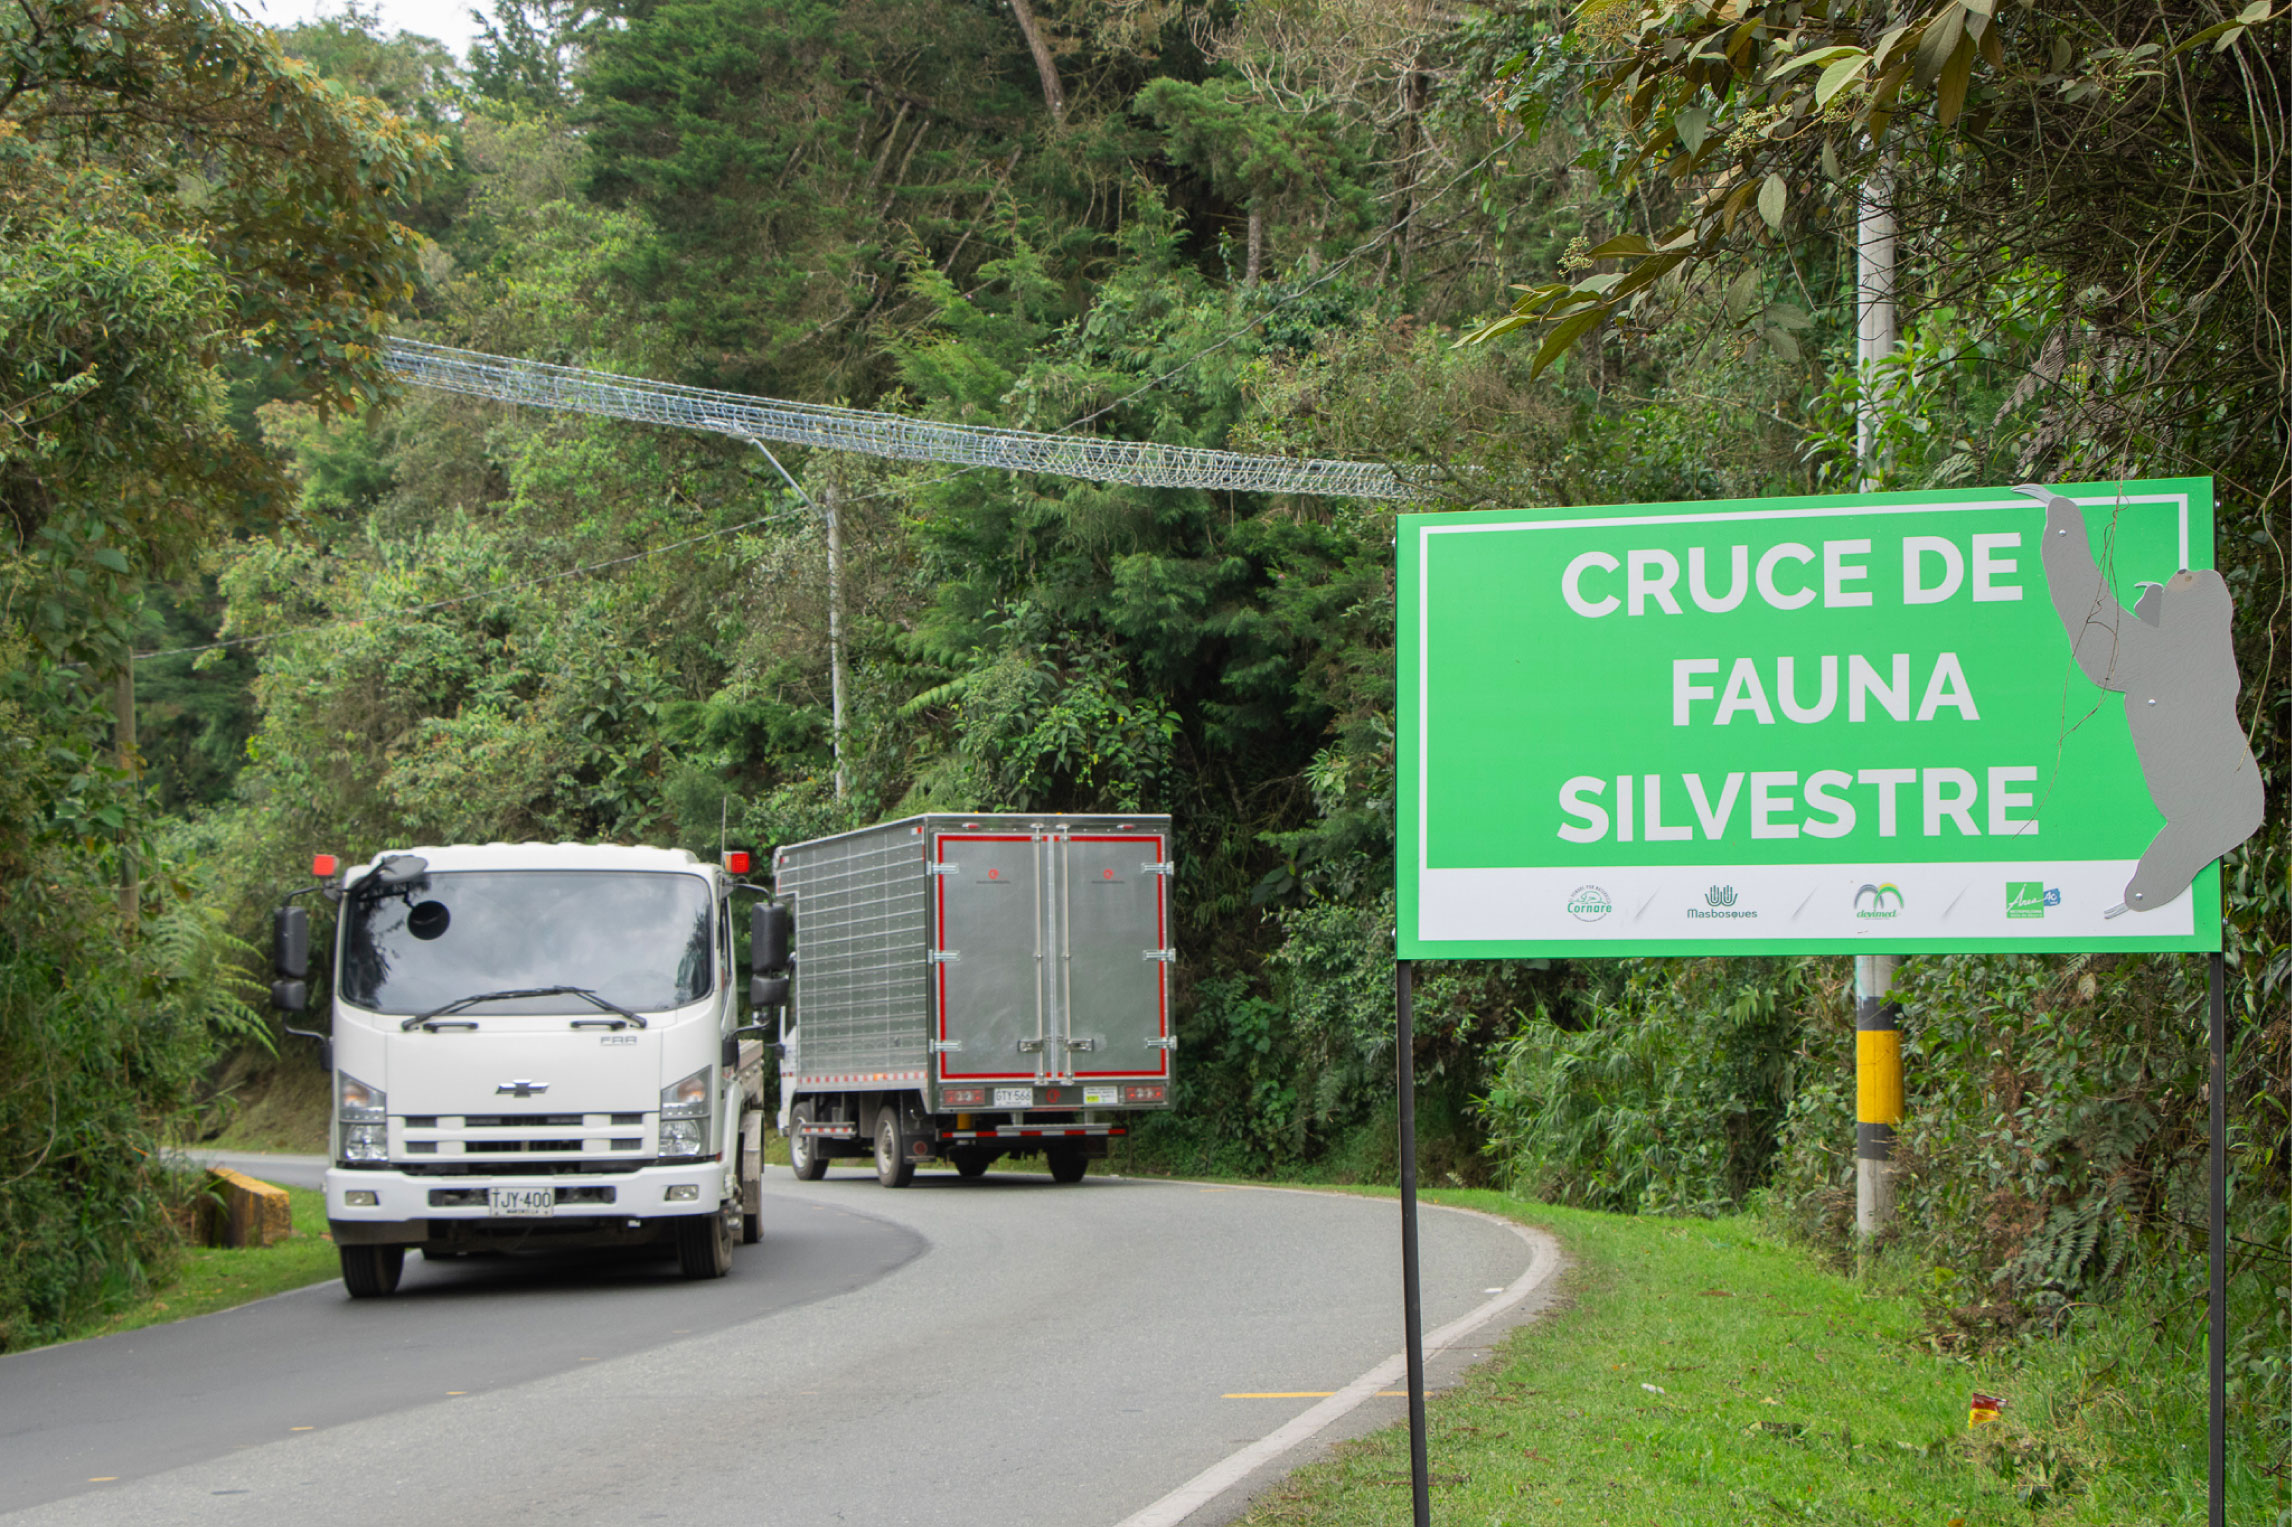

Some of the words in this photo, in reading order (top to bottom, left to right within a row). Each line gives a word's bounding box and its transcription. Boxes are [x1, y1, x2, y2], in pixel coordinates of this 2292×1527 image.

[1561, 538, 1873, 619] CRUCE
[1902, 532, 2023, 605] DE
[1672, 651, 1981, 727] FAUNA
[1556, 765, 2040, 844] SILVESTRE
[1567, 902, 1612, 914] Cornare
[1686, 908, 1758, 919] Masbosques
